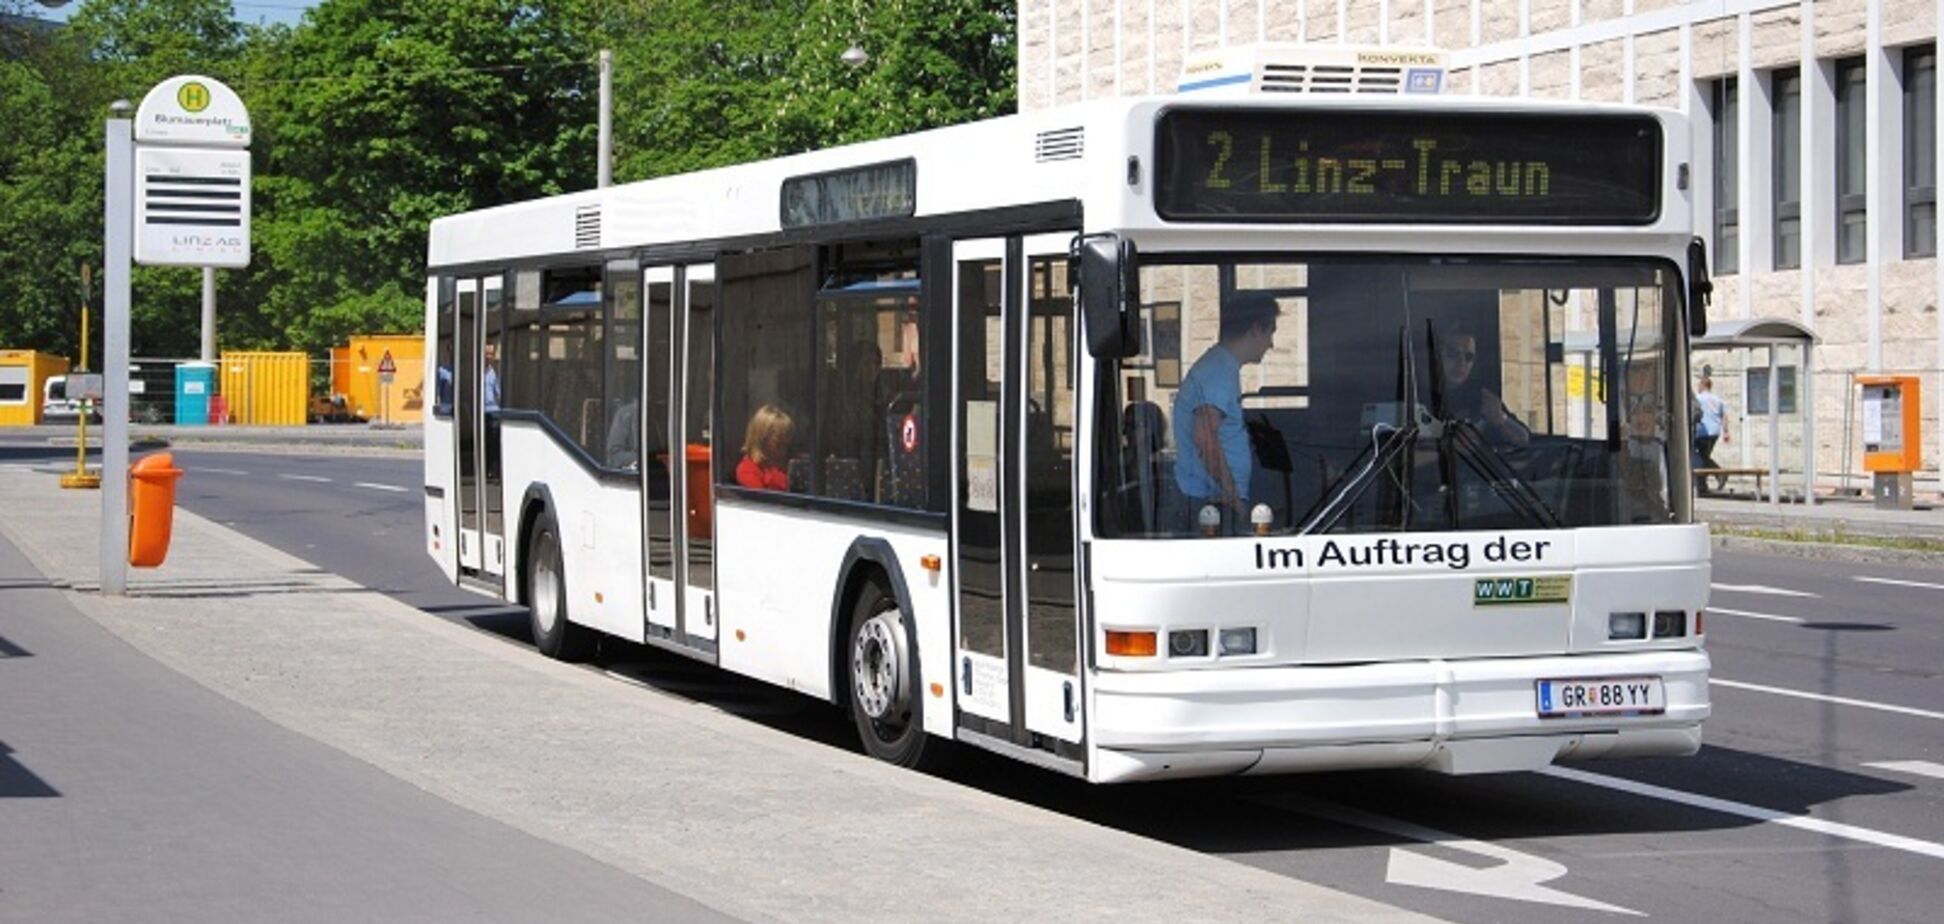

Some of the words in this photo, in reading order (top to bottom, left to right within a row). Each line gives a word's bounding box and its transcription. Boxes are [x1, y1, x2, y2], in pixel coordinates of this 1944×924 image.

[1206, 131, 1233, 189] 2
[1260, 135, 1551, 196] Linz-Traun
[1255, 543, 1304, 569] Im
[1317, 539, 1470, 570] Auftrag
[1484, 536, 1551, 562] der
[1476, 580, 1531, 597] WWT
[1562, 685, 1586, 707] GR
[1601, 684, 1624, 705] 88
[1628, 684, 1650, 705] YY
